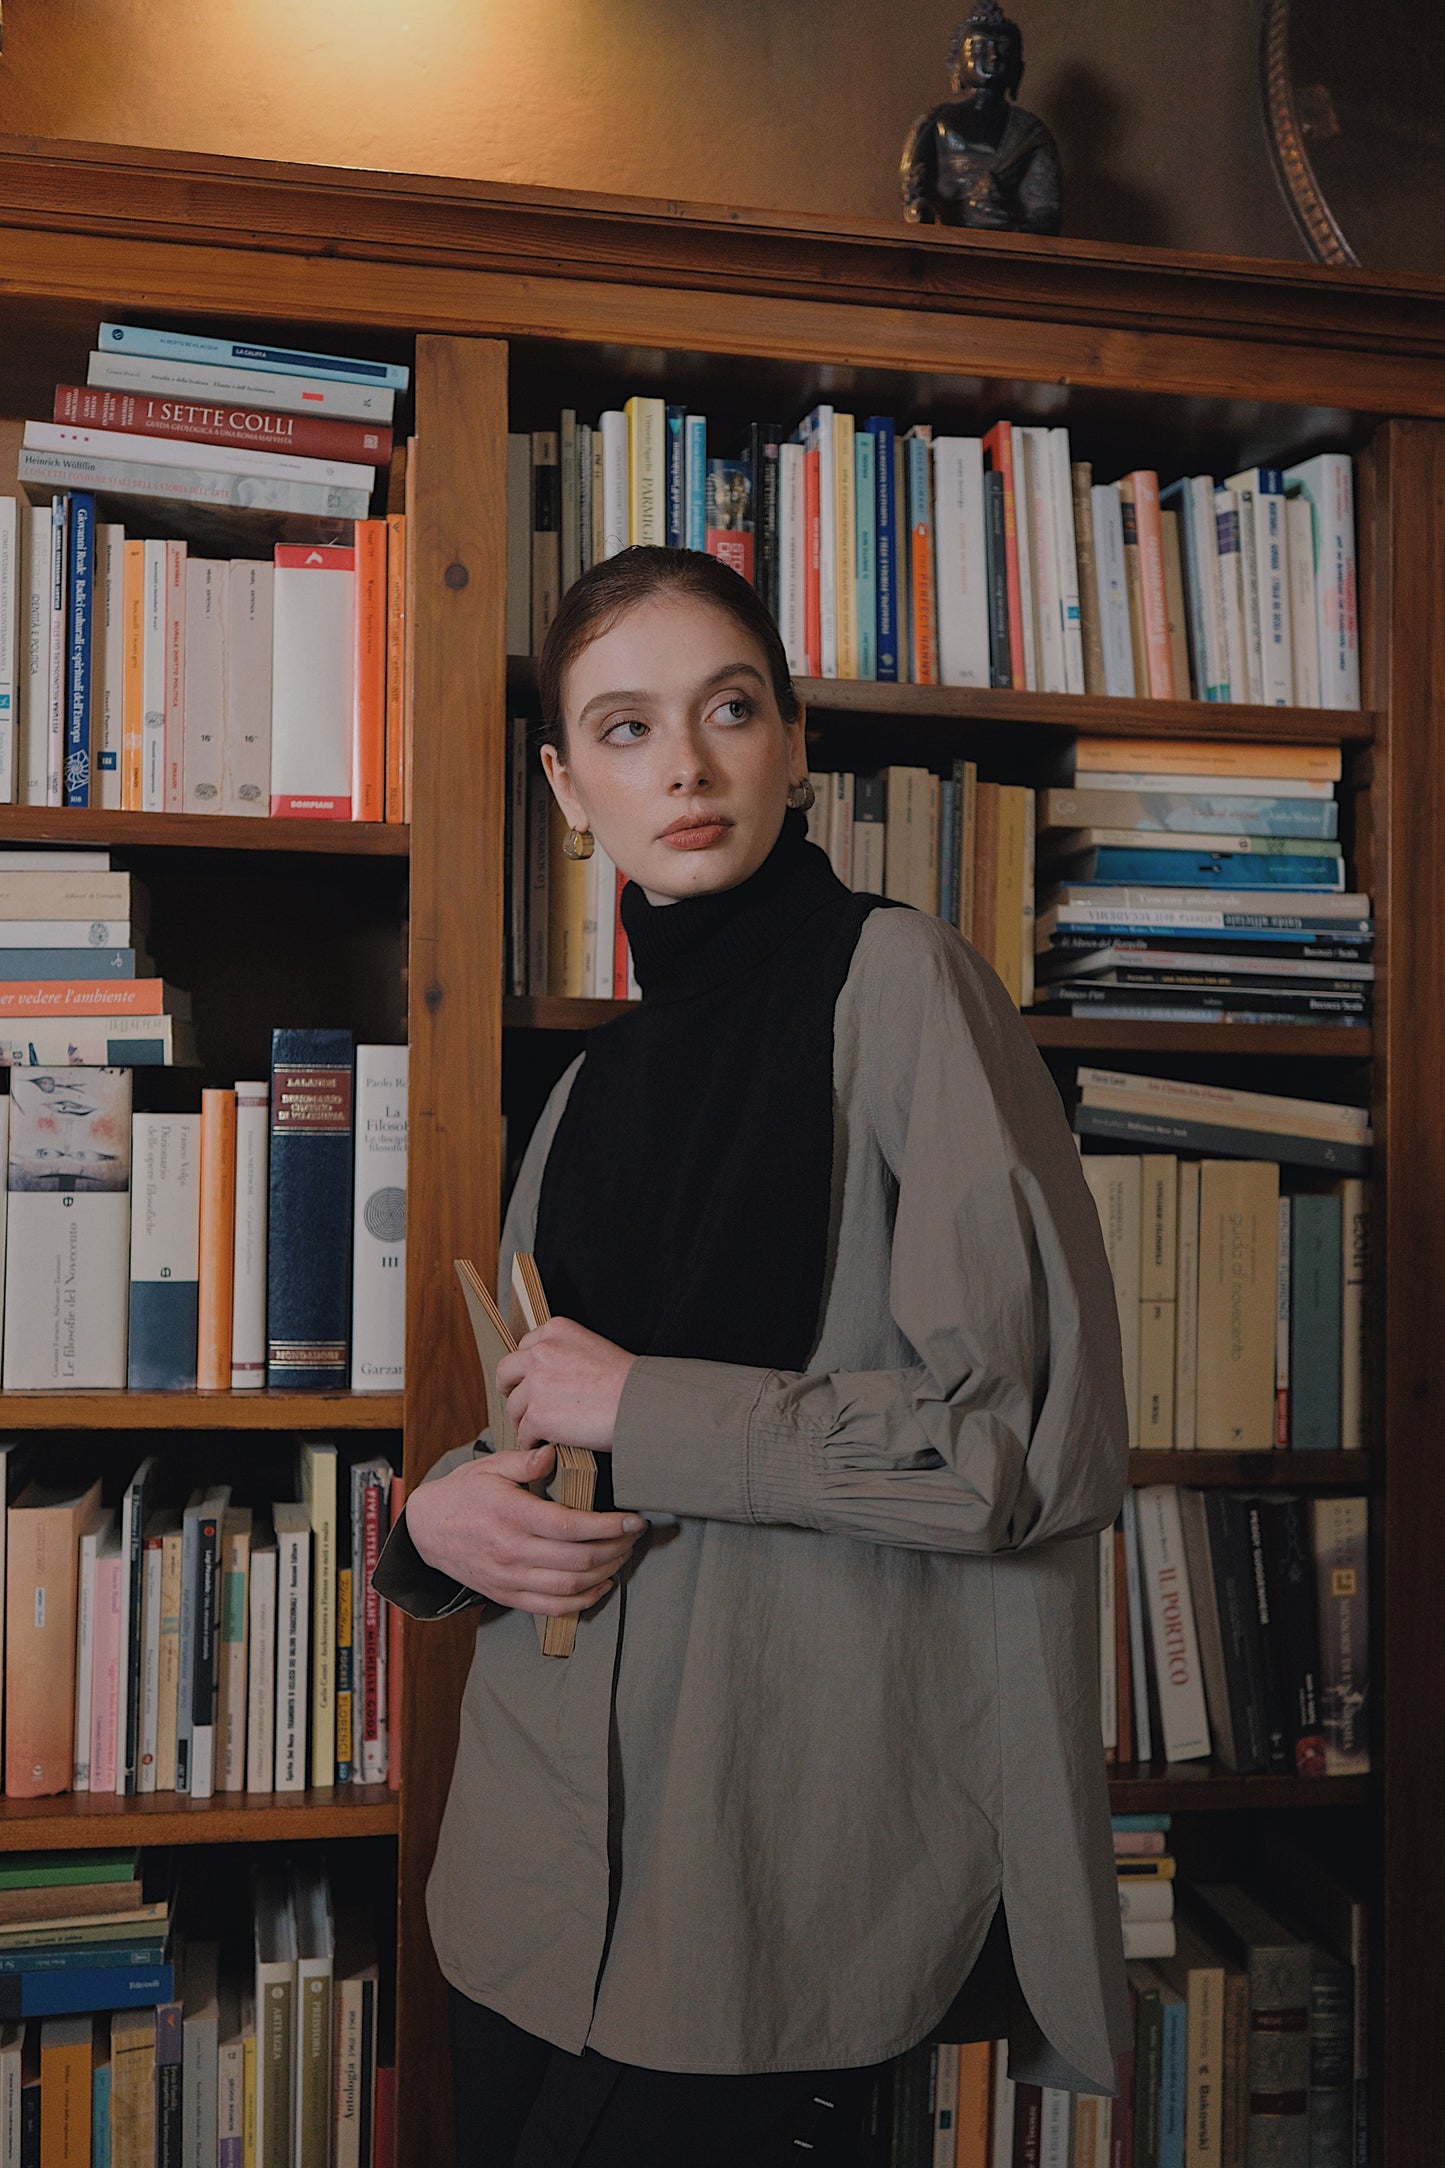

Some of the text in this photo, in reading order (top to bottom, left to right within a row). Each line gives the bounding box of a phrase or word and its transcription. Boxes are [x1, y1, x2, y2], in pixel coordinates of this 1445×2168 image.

[145, 420, 171, 431] GUIDA
[172, 422, 213, 436] GEOLOGICA
[146, 401, 293, 436] I SETTE COLLI
[25, 455, 96, 472] Heinrich Wölfflin
[615, 446, 623, 480] GIOVANNI
[641, 414, 656, 547] Vittorio Sgarbi PARMIGI
[671, 441, 681, 503] dell'architettura
[916, 446, 925, 514] LEILA SLIMANI
[24, 466, 230, 499] CONCETTI FONDAMENTALI DELLA STORIA DELL'ARTE
[1, 530, 9, 550] COME
[75, 508, 87, 575] Giovanni Reale
[1, 551, 9, 584] STUDIARE
[0, 585, 8, 608] L'ARTE
[31, 593, 41, 628] IDENTITÀ
[75, 579, 86, 607] Radici
[919, 573, 929, 630] PERFECT
[74, 607, 86, 644] culturali
[789, 605, 797, 645] RACCONTI
[30, 638, 40, 675] POLITICA
[71, 651, 85, 691] spirituali
[172, 620, 180, 708] MORALE DIRITTO POLITICA
[921, 635, 930, 676] NANNY
[52, 652, 60, 701] RICONOSCERE
[71, 692, 84, 743] dell'Europa
[290, 800, 334, 809] BOMPIANI
[1138, 893, 1241, 906] Toscana medievale
[1089, 909, 1222, 927] Galleria dell'ACCADEMIA
[1225, 915, 1302, 929] Guida ufficiale
[0, 989, 136, 1005] er vedere l'ambiente
[281, 1093, 342, 1104] DIZIONARIO
[286, 1077, 337, 1088] LALANDE
[366, 1077, 392, 1088] Paolo
[278, 1110, 290, 1121] DI
[386, 1106, 401, 1119] La
[160, 1125, 171, 1180] Dizionario
[177, 1125, 190, 1186] Franco Volpi
[364, 1134, 377, 1143] Le
[144, 1125, 158, 1236] delle opere filosofiche
[1228, 1214, 1246, 1259] guida
[1348, 1212, 1369, 1287] Lucca
[382, 1257, 399, 1268] III
[63, 1222, 78, 1377] Le filosofie del Novecento
[1230, 1282, 1244, 1362] novecento
[52, 1348, 60, 1378] Giovanni
[365, 1488, 377, 1520] FIVE
[289, 1543, 298, 1564] Editore
[365, 1523, 377, 1565] LITTLE
[202, 1550, 213, 1593] Luigi Pirandello
[1248, 1509, 1269, 1625] PEGGY GUGGENHEIM
[321, 1579, 329, 1605] Firenze
[288, 1598, 297, 1636] TRADIZIONALI
[1157, 1568, 1189, 1687] IL PORTICO
[288, 1638, 296, 1657] VALORI
[321, 1613, 329, 1658] Architettura
[339, 1649, 349, 1690] POCKET
[365, 1631, 377, 1738] MICHELLE GOOD
[287, 1699, 295, 1730] TRAMONTO
[320, 1687, 328, 1709] Carlo
[338, 1695, 349, 1758] FLORENCE
[273, 2007, 283, 2032] ARTE
[311, 2001, 322, 2058] PREISTORIA
[273, 2034, 283, 2060] EGEA
[343, 2063, 357, 2121] Antologia
[1199, 2085, 1210, 2150] Bukowski
[1358, 2131, 1368, 2164] Guida
